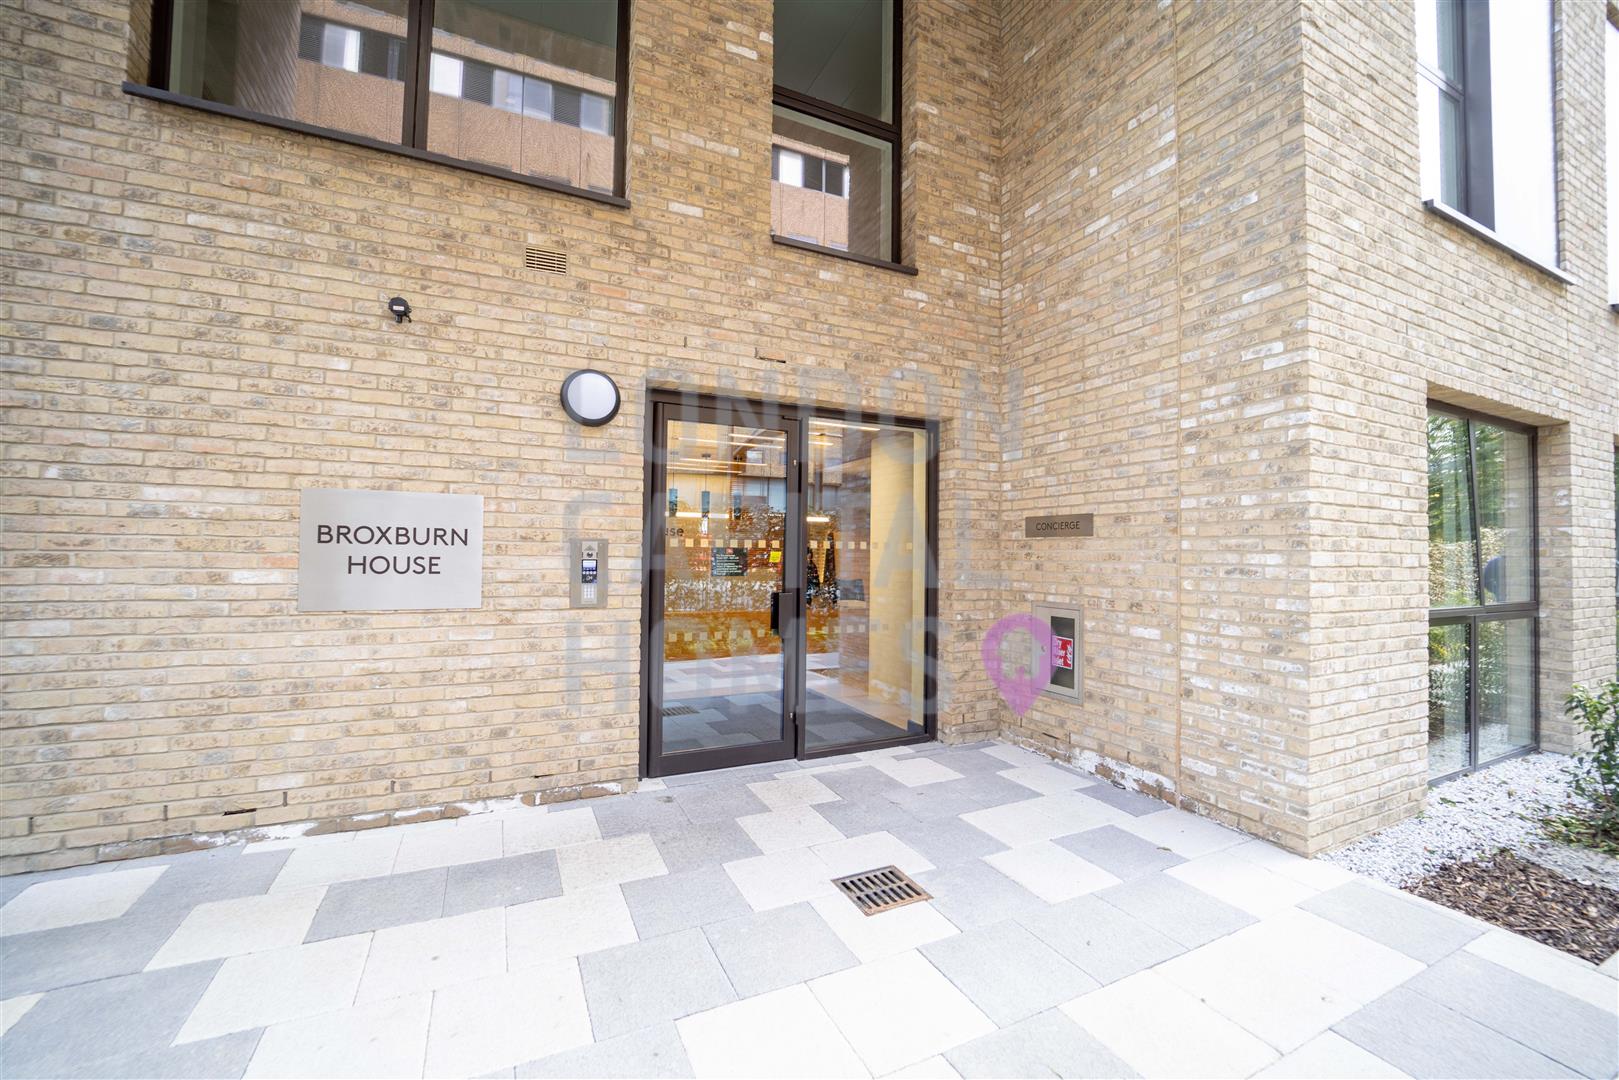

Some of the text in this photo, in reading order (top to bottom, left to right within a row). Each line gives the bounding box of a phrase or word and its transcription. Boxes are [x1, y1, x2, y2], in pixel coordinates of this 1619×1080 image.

[317, 524, 469, 546] BROXBURN
[1035, 520, 1081, 531] CONCIERGE
[347, 555, 441, 575] HOUSE
